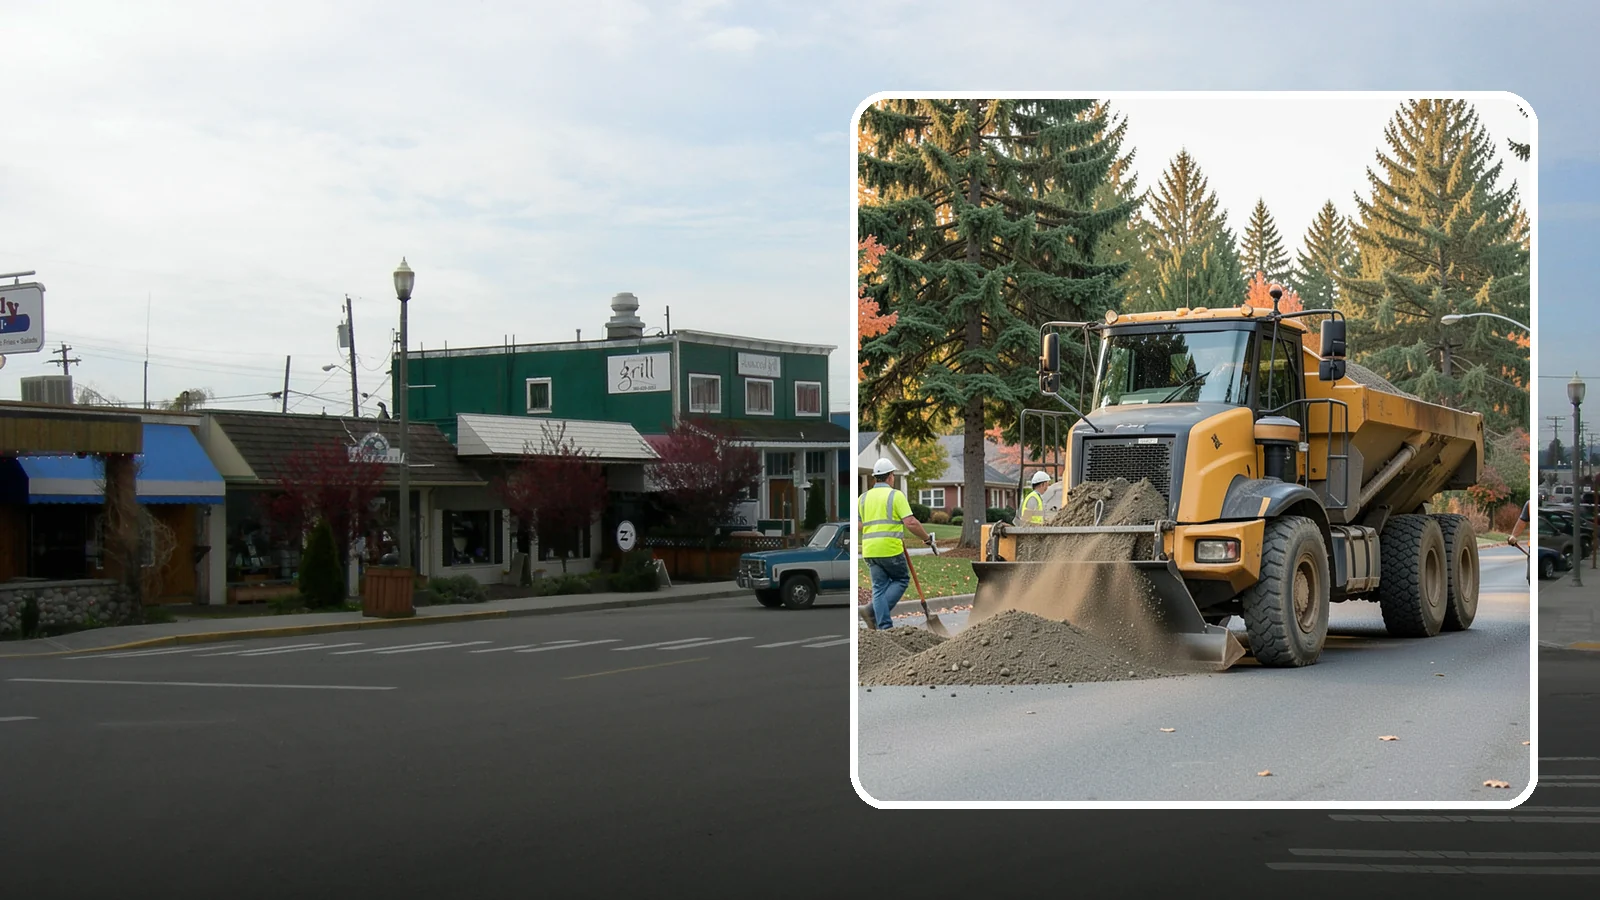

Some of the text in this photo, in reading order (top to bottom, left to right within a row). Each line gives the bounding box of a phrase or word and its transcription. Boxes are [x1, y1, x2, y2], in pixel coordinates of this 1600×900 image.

[3, 336, 38, 346] Fries Salads
[618, 356, 654, 391] grill
